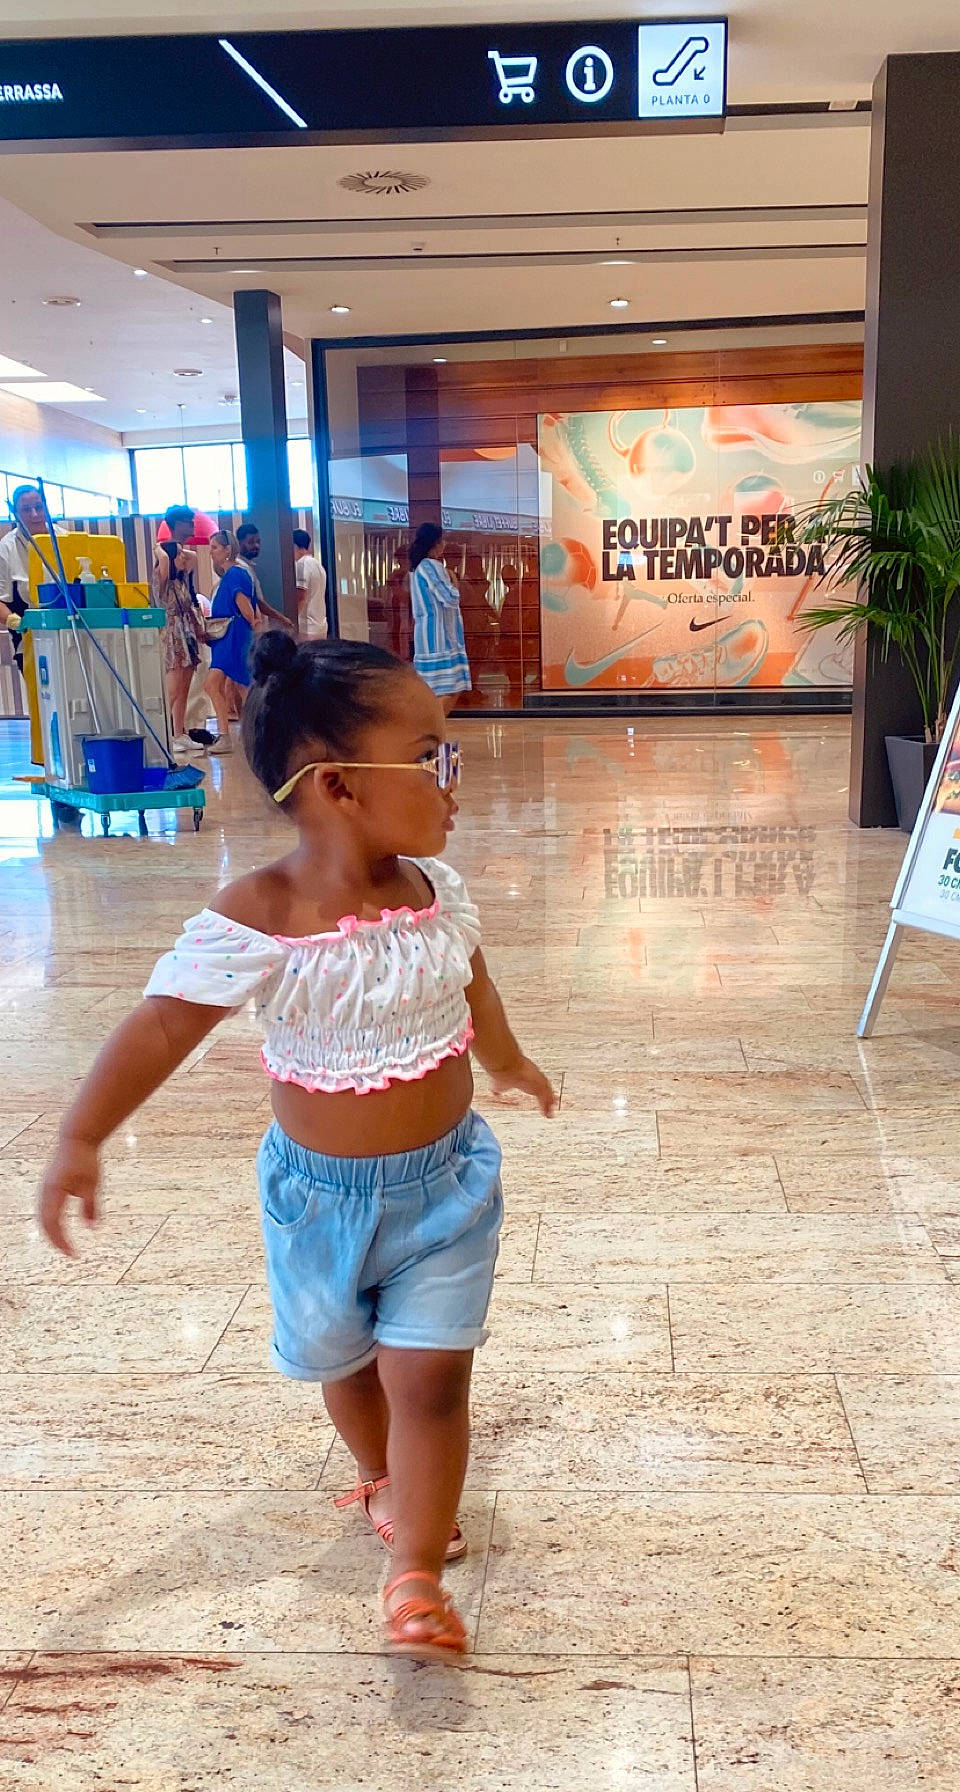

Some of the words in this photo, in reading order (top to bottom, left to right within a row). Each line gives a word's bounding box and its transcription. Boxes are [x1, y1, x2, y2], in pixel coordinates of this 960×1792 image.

[651, 94, 699, 106] PLANTA
[602, 515, 733, 551] EQUIPA'T
[741, 514, 796, 546] PER
[602, 551, 636, 582] LA
[643, 545, 825, 581] TEMPORADA
[667, 592, 704, 604] Oferta
[706, 590, 756, 606] especial.
[938, 874, 951, 887] 30
